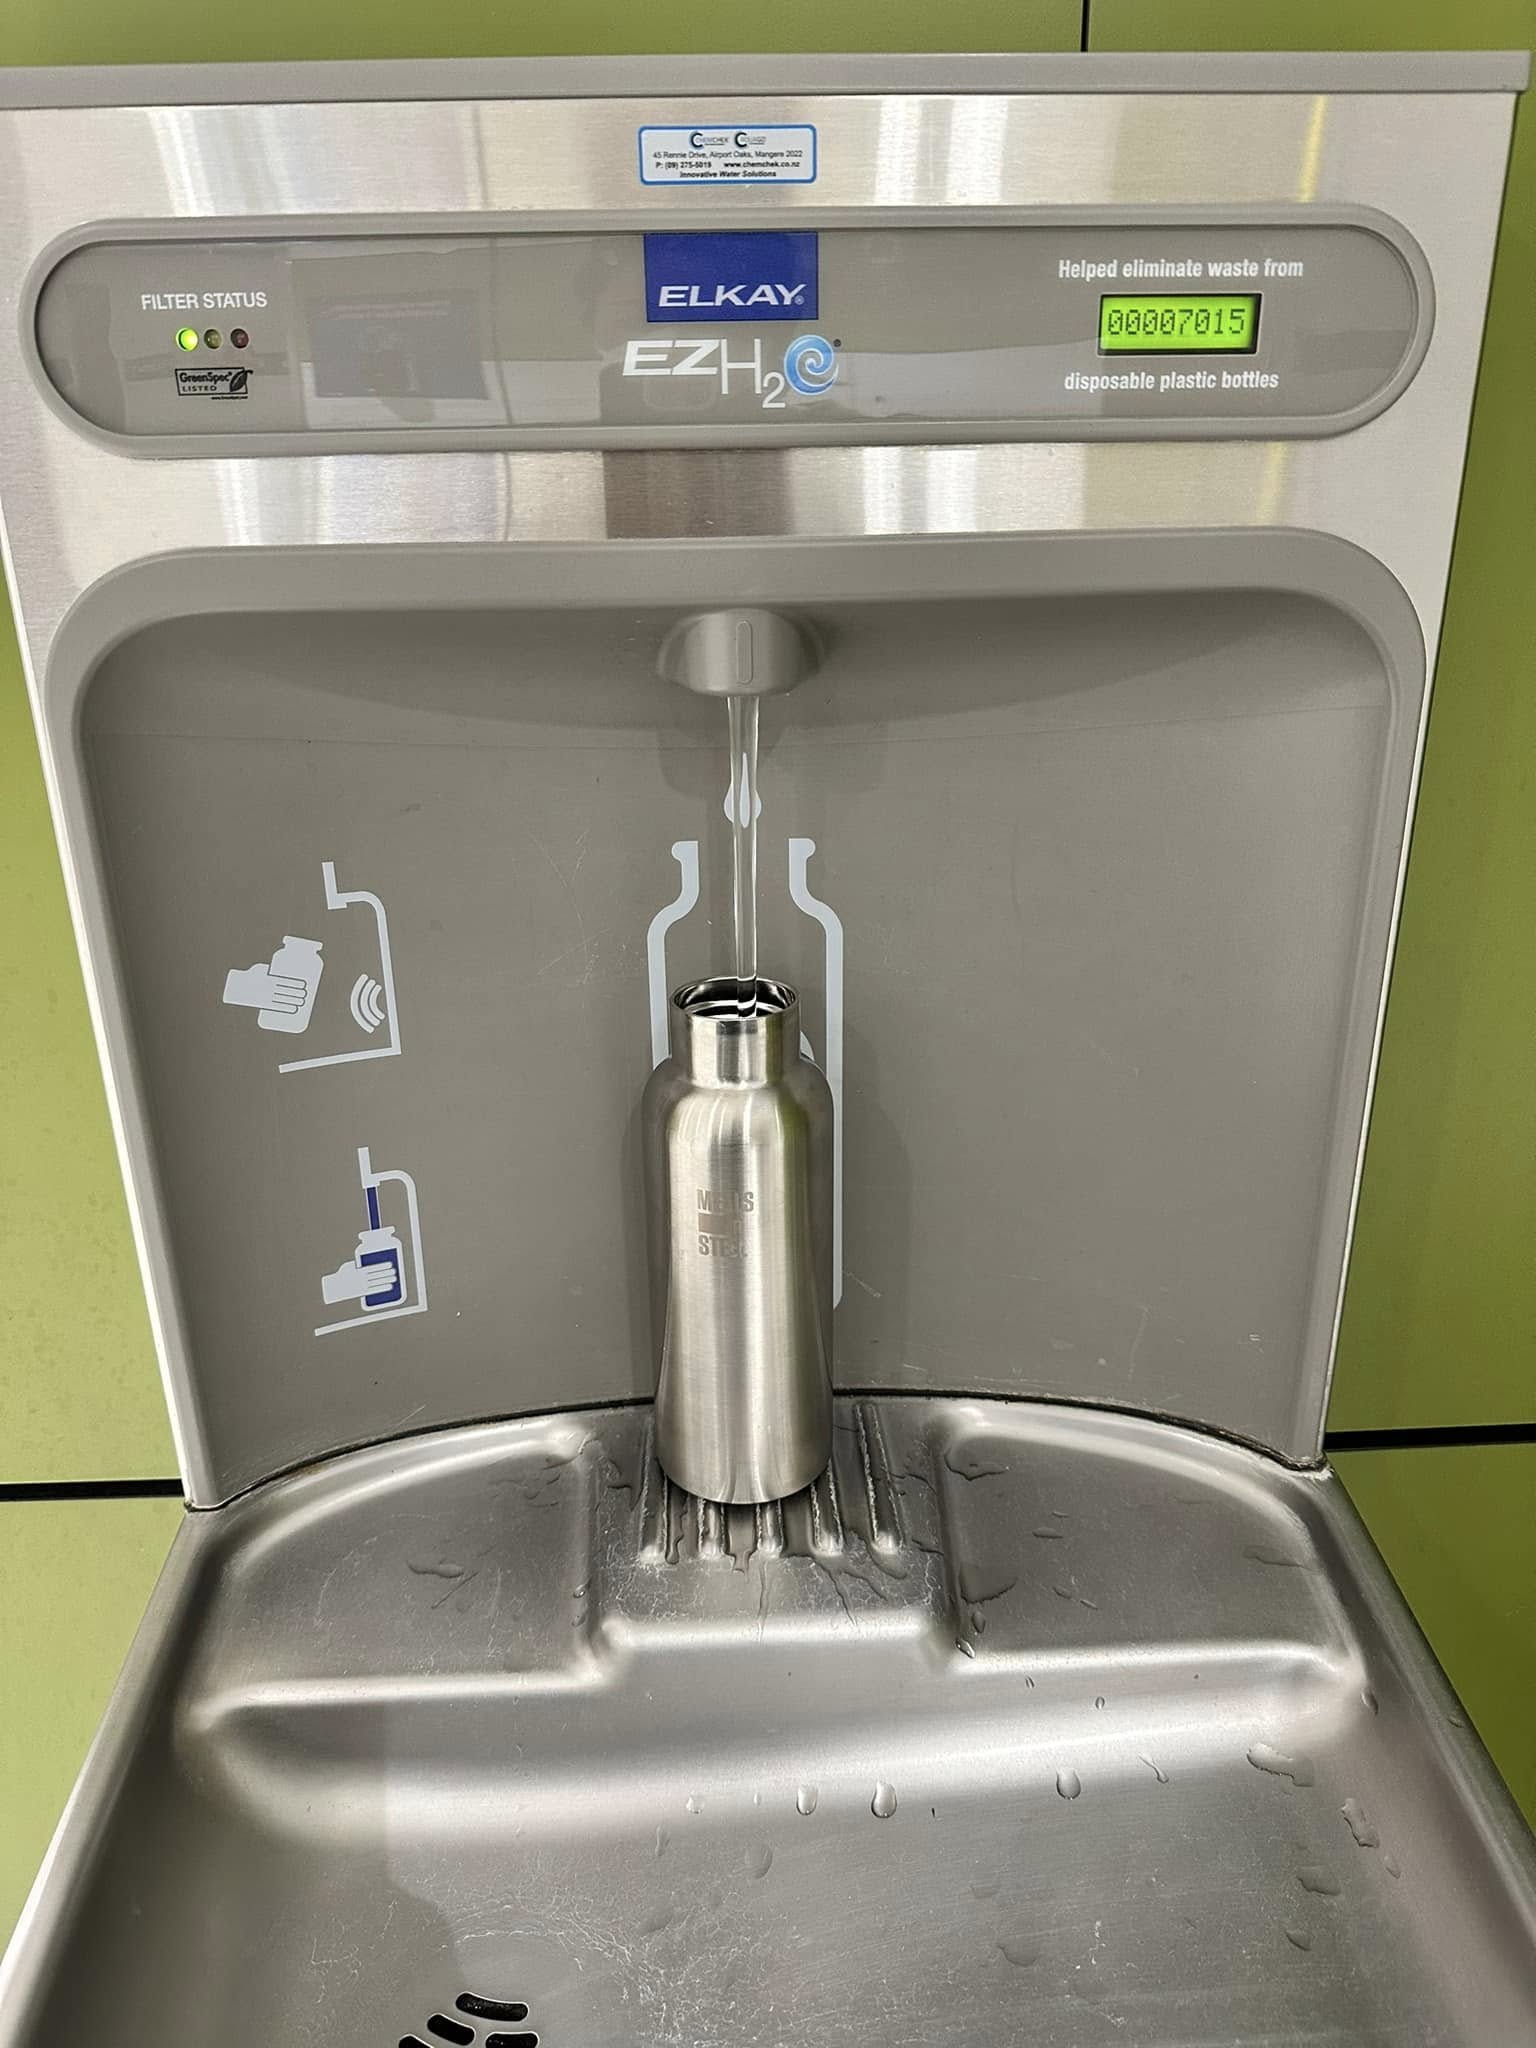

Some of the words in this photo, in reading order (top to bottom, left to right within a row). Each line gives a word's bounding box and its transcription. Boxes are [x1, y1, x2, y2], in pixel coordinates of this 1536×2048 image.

[653, 151, 661, 159] 45
[663, 151, 687, 159] Rennie
[688, 151, 708, 159] Drive,
[709, 151, 732, 160] Airport
[755, 150, 784, 159] Mangere
[786, 149, 803, 158] 2022
[724, 160, 800, 168] www.chemchek.co.nz
[719, 170, 740, 178] Water
[742, 169, 776, 178] Solutions
[1058, 260, 1117, 281] Helped
[1122, 259, 1202, 278] eliminate
[1208, 259, 1259, 277] waste
[1264, 258, 1304, 277] from
[141, 293, 199, 310] FILTER
[202, 291, 268, 309] STATUS
[1107, 308, 1246, 335] 00007015
[182, 385, 217, 393] LISTED
[1064, 372, 1155, 393] disposable
[1160, 371, 1217, 392] plastic
[1221, 370, 1280, 389] bottles
